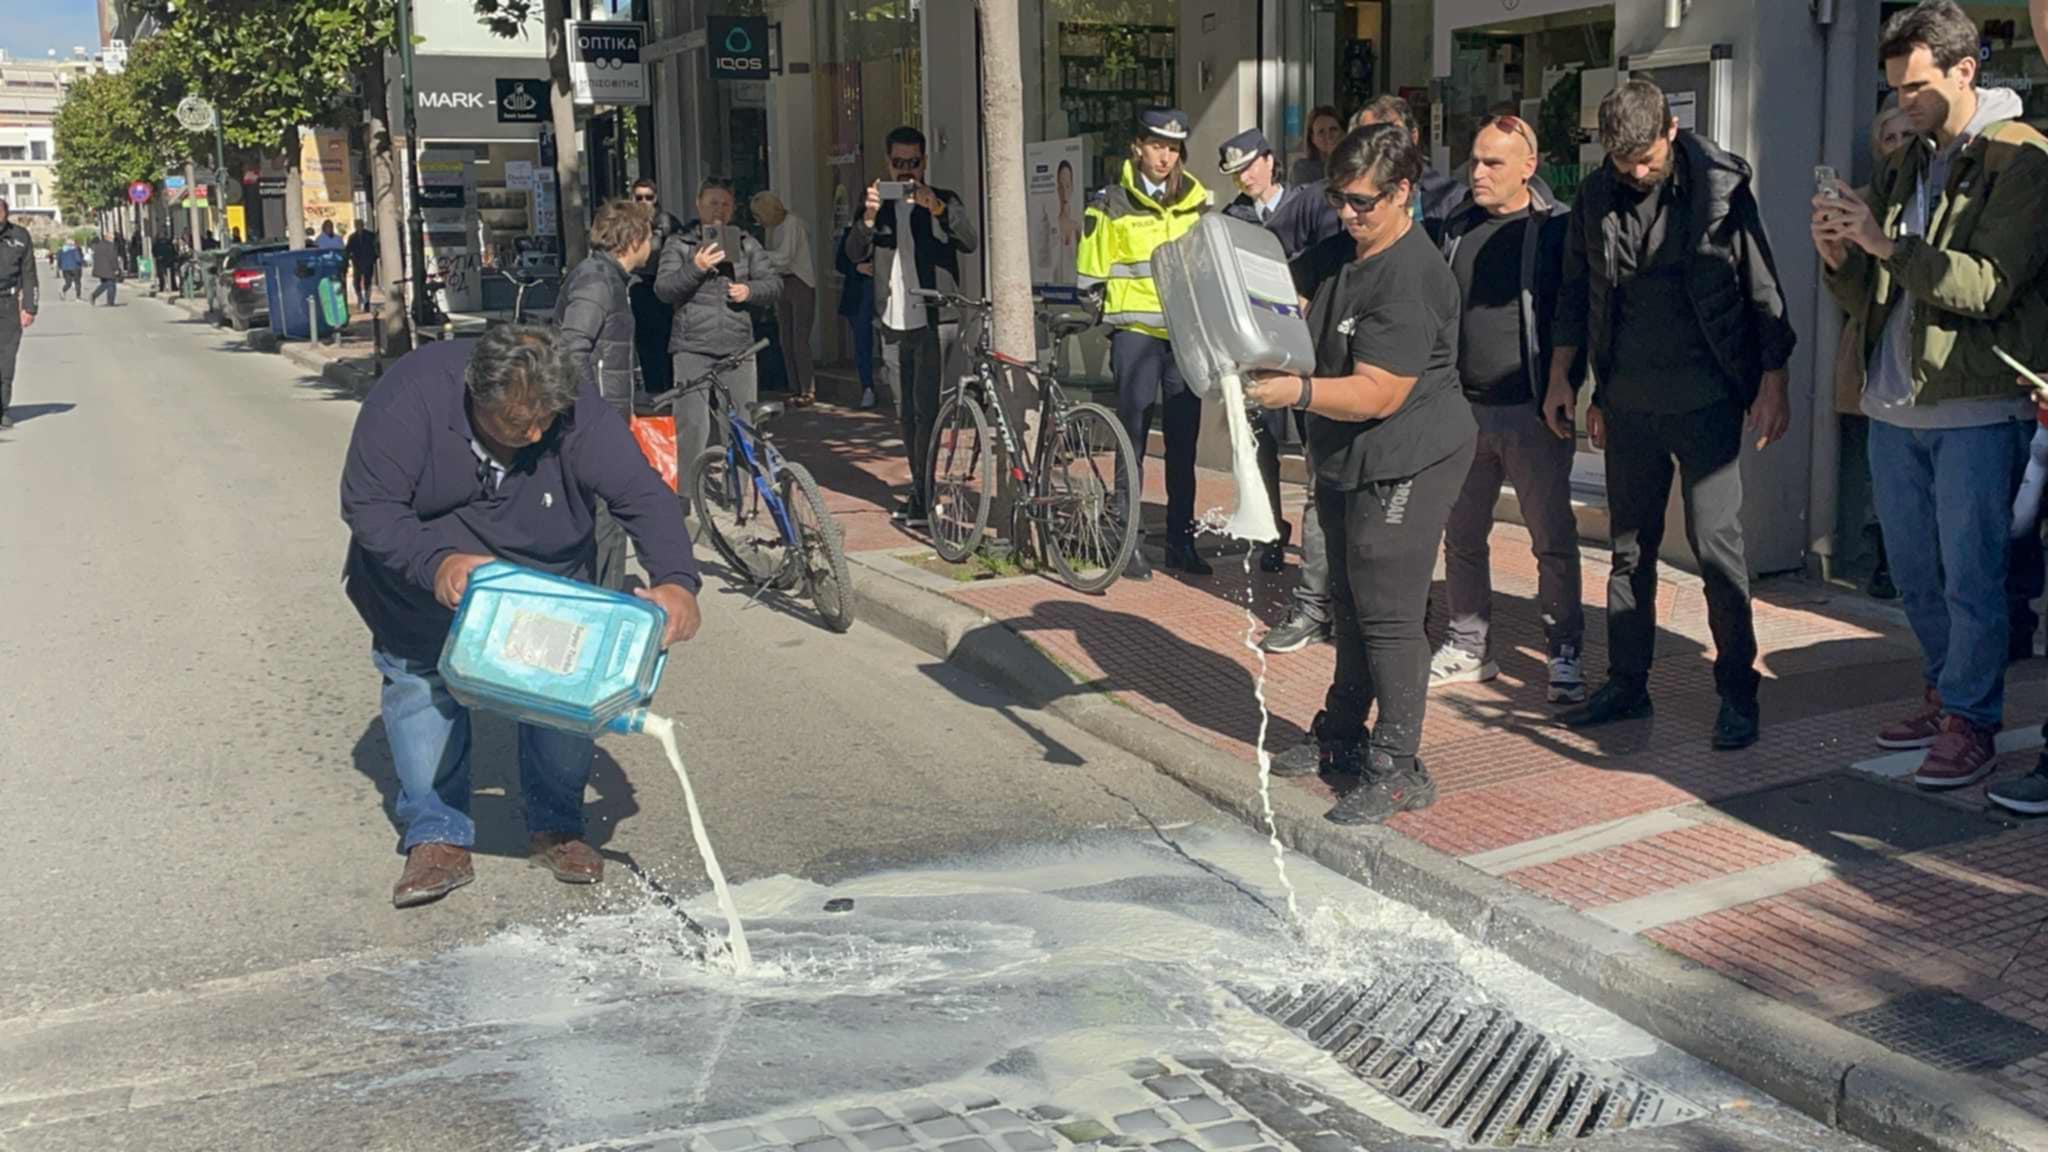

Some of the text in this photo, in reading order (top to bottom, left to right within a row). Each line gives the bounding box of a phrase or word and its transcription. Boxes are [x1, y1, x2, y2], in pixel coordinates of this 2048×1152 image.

[578, 36, 637, 50] ΟΠΤΙΚΑ
[716, 57, 762, 71] IQOS
[1981, 72, 2033, 91] Blemish
[418, 91, 484, 109] MARK
